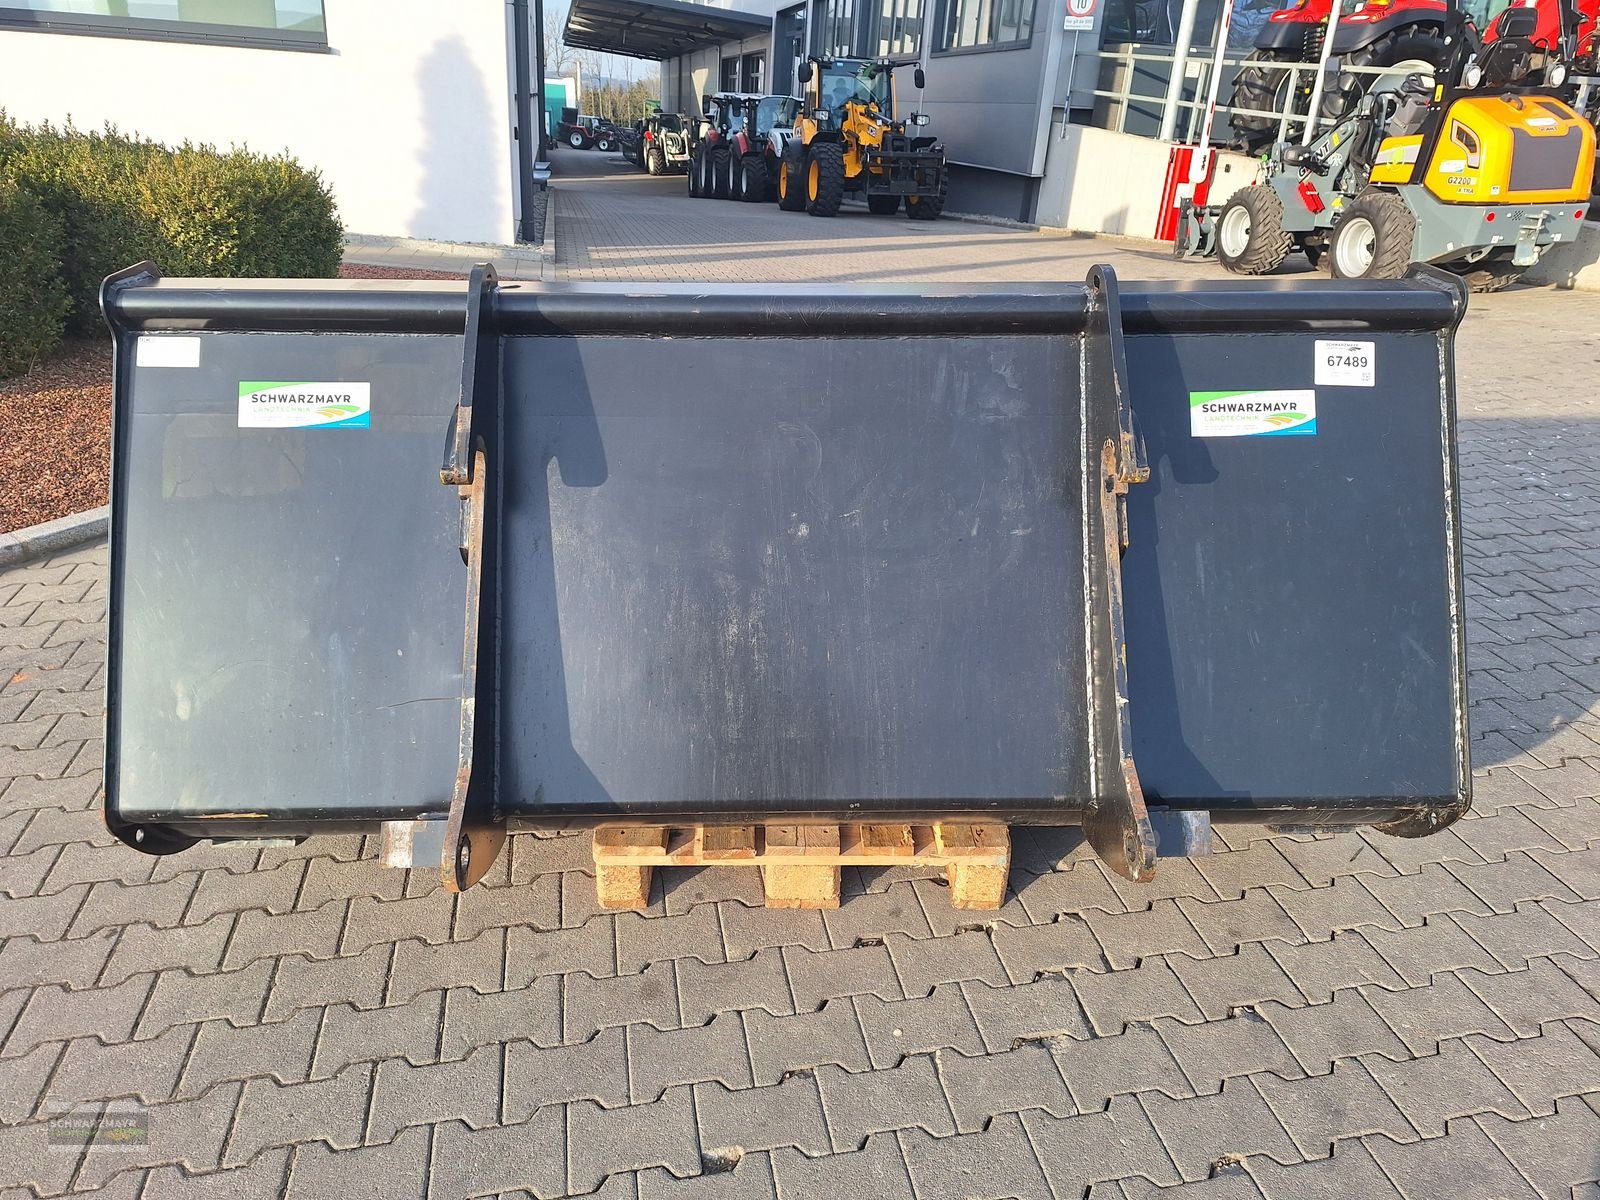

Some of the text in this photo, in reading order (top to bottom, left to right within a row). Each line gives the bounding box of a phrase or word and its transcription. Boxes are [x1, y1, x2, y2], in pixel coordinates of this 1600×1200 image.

[1447, 176, 1472, 185] G2200
[1327, 355, 1368, 368] 67489
[251, 393, 351, 404] SCHWARZMAYR
[1202, 402, 1297, 413] SCHWARZMAYR
